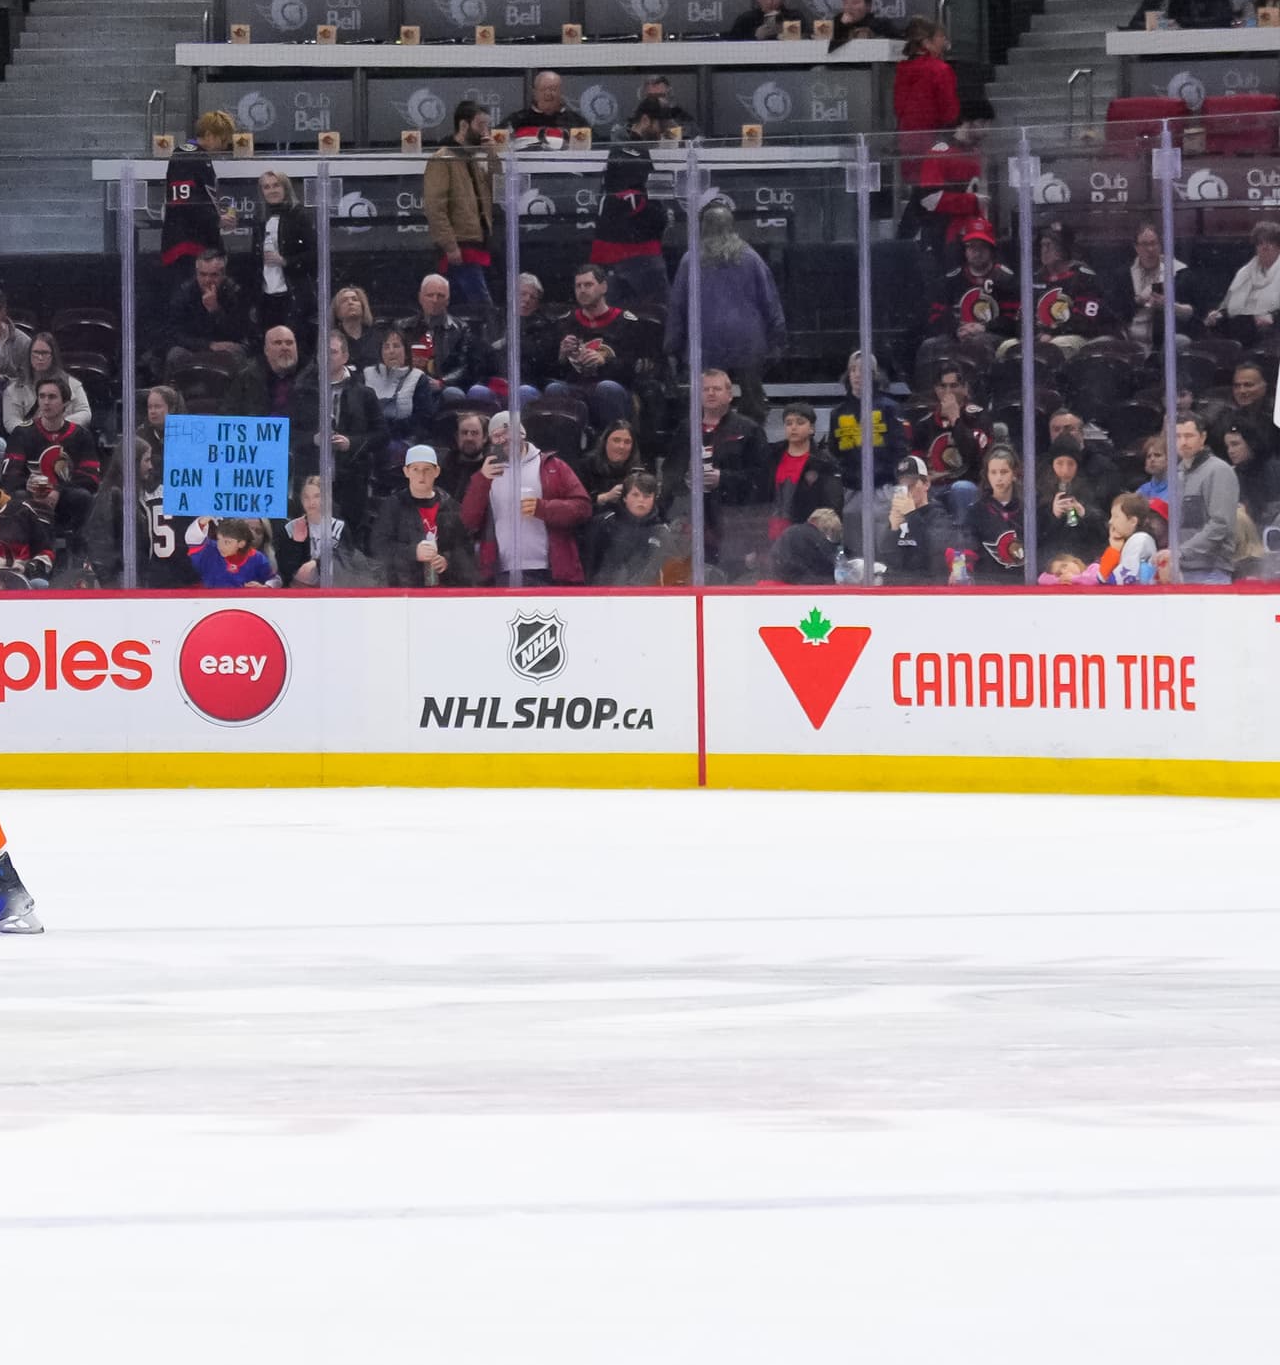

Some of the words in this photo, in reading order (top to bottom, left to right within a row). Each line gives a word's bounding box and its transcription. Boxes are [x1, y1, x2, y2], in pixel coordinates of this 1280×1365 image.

[326, 10, 362, 30] Bell
[505, 5, 542, 26] Bell
[687, 1, 723, 22] Bell
[294, 109, 331, 131] Bell
[812, 100, 848, 122] Bell
[1091, 172, 1129, 189] Club
[172, 183, 191, 201] 19
[397, 192, 425, 210] Clu
[756, 187, 794, 205] Club
[217, 422, 247, 442] IT'S
[256, 423, 283, 442] MY
[170, 468, 203, 488] CAN
[214, 468, 220, 487] I
[233, 468, 275, 488] HAVE
[178, 492, 189, 511] A
[213, 492, 273, 512] STICK?
[520, 629, 556, 668] NHL
[199, 652, 267, 682] easy
[892, 652, 1106, 709] CANADIAN
[1116, 654, 1197, 712] TIRE
